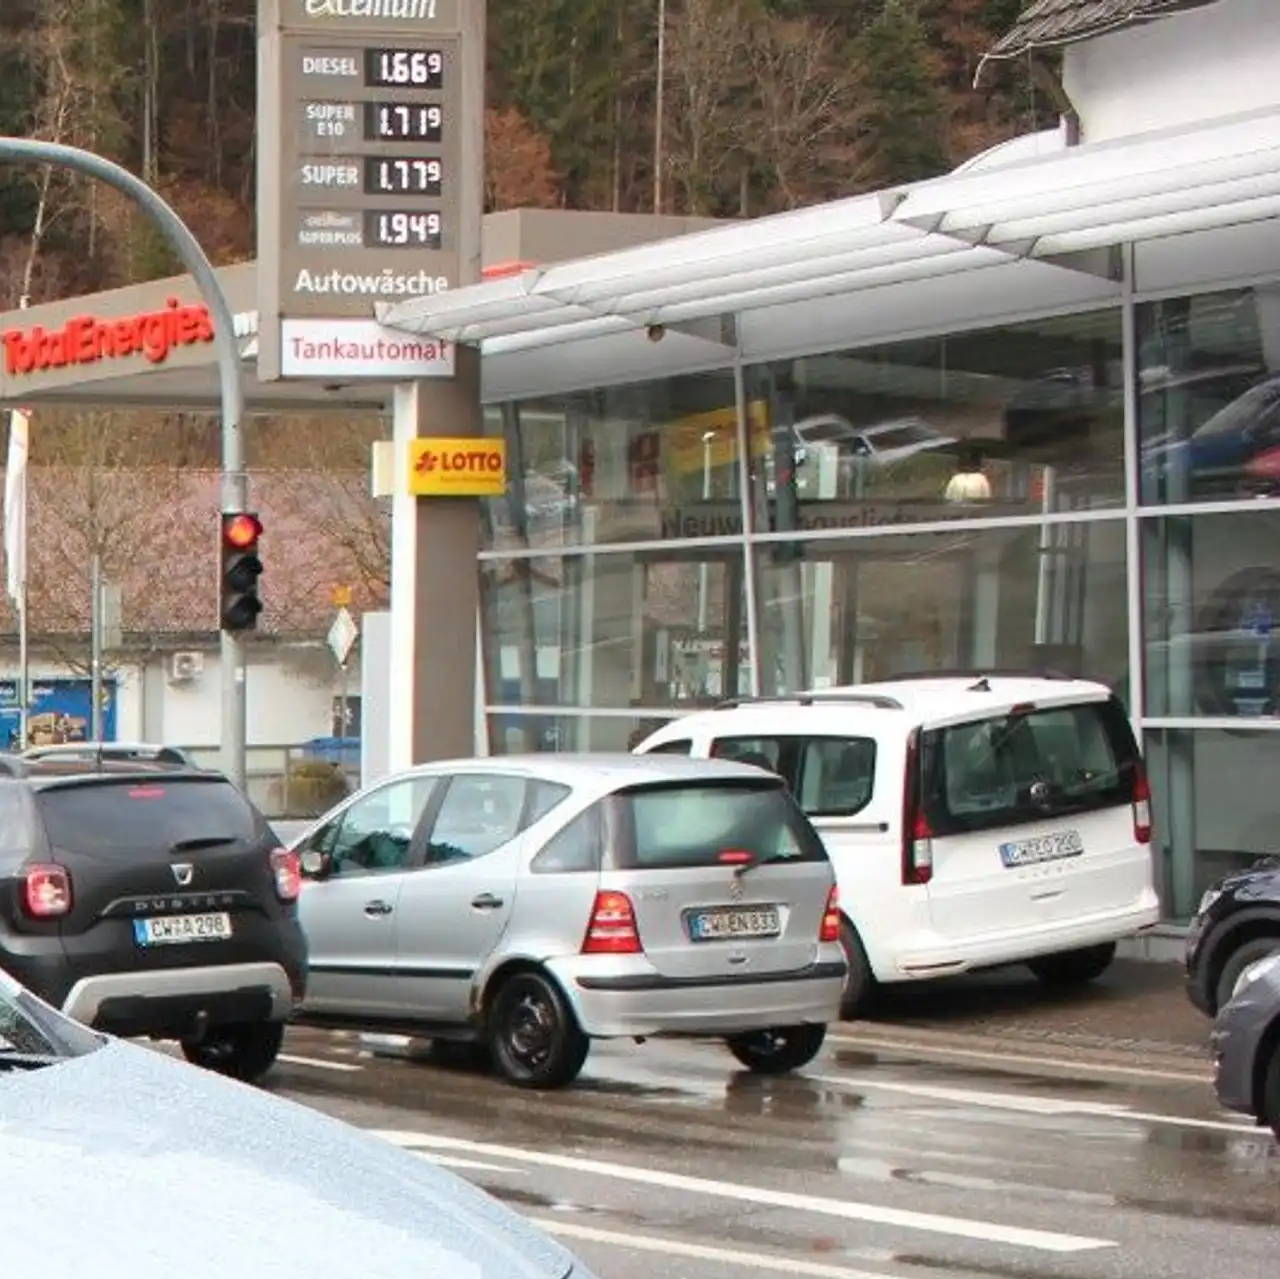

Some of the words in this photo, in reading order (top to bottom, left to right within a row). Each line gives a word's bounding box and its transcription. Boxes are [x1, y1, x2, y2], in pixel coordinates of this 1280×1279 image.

[302, 57, 359, 76] DIESEL
[305, 104, 355, 121] SUPER
[317, 121, 345, 136] E10
[301, 164, 359, 185] SUPER
[293, 268, 448, 294] Autowäsche
[0, 297, 215, 374] TotalEnergies
[291, 337, 447, 361] Tankautomat
[441, 451, 502, 472] LOTTO
